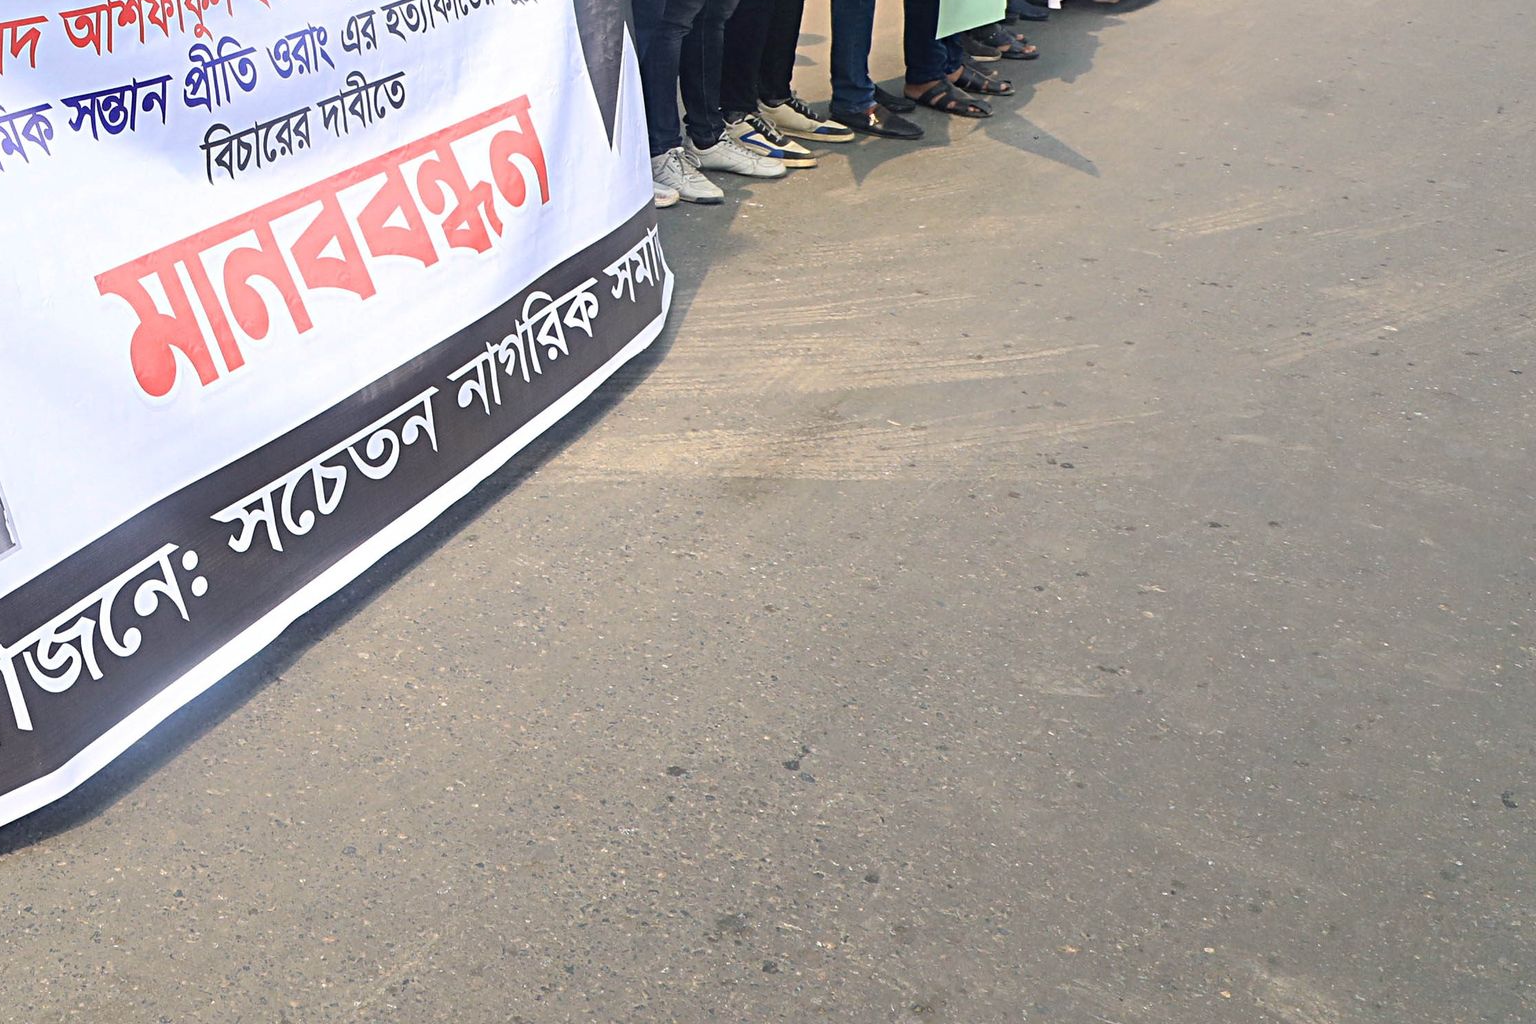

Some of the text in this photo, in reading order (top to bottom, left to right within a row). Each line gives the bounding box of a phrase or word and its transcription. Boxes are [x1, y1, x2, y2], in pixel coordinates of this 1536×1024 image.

[62, 73, 173, 143] সন্তান
[184, 36, 257, 111] প্রীতি
[266, 22, 336, 84] ওরাং
[340, 6, 380, 57] এর
[200, 70, 408, 188] বিচারের দাবীতে
[95, 94, 549, 399] মানববন্ধন
[211, 387, 439, 559] সচেতন
[448, 277, 599, 418] নাগরিক
[601, 224, 660, 312] সমা
